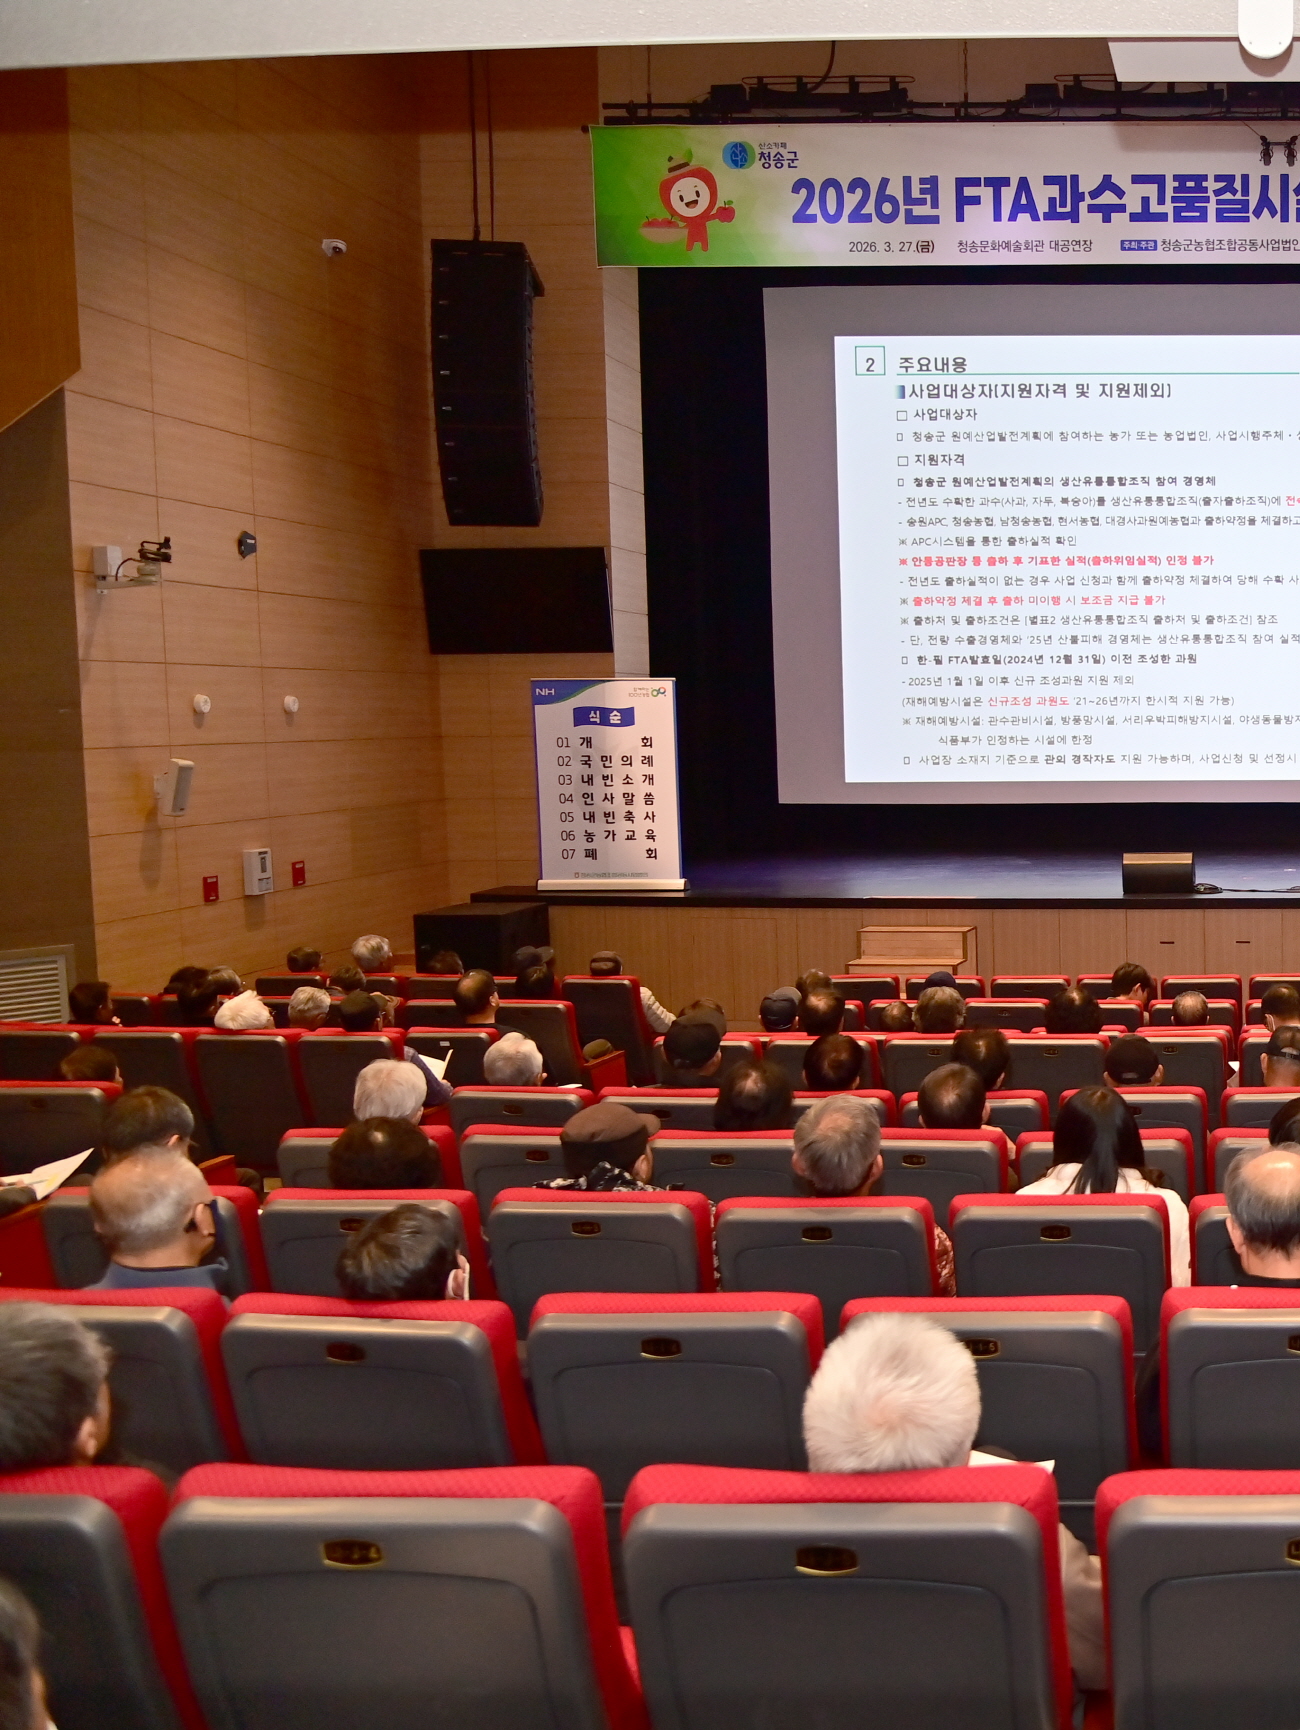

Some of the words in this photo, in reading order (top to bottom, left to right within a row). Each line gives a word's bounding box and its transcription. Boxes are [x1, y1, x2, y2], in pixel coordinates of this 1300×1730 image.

[758, 151, 799, 170] 청송군
[791, 175, 940, 225] 2026년
[849, 241, 880, 253] 2026.
[884, 241, 894, 253] 3.
[899, 240, 935, 254] 27.(금)
[957, 239, 1045, 254] 청송문화예술회관
[1049, 239, 1093, 253] 대공연장
[866, 357, 875, 372] 2
[899, 357, 967, 373] 주요내용
[1076, 383, 1089, 398] 및
[914, 408, 977, 421] 사업대상자
[913, 431, 946, 442] 청송군
[1059, 431, 1104, 441] 참여하는
[1109, 431, 1131, 441] 농가
[1136, 431, 1158, 441] 또는
[1216, 430, 1283, 441] 사업시행주체
[915, 454, 964, 466] 지원자격
[913, 477, 947, 487] 청송군
[1156, 476, 1177, 486] 참여
[1183, 476, 1215, 486] 경영체
[906, 497, 938, 507] 전년도
[1106, 516, 1201, 526] 대경사과원예농협과
[1013, 556, 1023, 566] 후
[1028, 556, 1061, 566] 기표한
[1166, 556, 1187, 565] 인정
[908, 577, 940, 587] 전년도
[1004, 576, 1024, 586] 없는
[1029, 576, 1050, 586] 경우
[1054, 576, 1075, 586] 사업
[1080, 575, 1112, 586] 신청과
[1116, 576, 1137, 585] 함께
[1190, 575, 1232, 585] 체결하여
[1237, 575, 1257, 585] 당해
[962, 596, 982, 606] 체결
[987, 596, 998, 606] 후
[1029, 596, 1060, 606] 미이행
[1066, 596, 1075, 605] 시
[1080, 595, 1113, 605] 보조금
[1118, 595, 1139, 605] 지급
[951, 616, 960, 625] 및
[1191, 615, 1200, 624] 및
[1257, 615, 1278, 624] 참조
[1108, 635, 1152, 644] 경영체는
[1253, 634, 1273, 644] 참여
[1050, 654, 1072, 664] 12월
[1111, 654, 1132, 664] 이전
[1138, 654, 1171, 664] 조성한
[1175, 654, 1197, 664] 과원
[909, 677, 942, 686] 2025년
[947, 676, 963, 686] 1월
[968, 676, 983, 686] 1일
[989, 676, 1010, 686] 이후
[1014, 676, 1035, 686] 신규
[1040, 676, 1082, 686] 조성과원
[1088, 675, 1108, 685] 지원
[1113, 676, 1133, 685] 제외
[536, 688, 555, 696] NH
[988, 697, 1031, 706] 신규조성
[1036, 696, 1069, 706] 과원도
[1146, 696, 1177, 706] 한시적
[1184, 696, 1204, 705] 지원
[556, 737, 571, 748] 01
[939, 736, 982, 746] 식품부가
[987, 735, 1030, 745] 인정하는
[1035, 735, 1066, 745] 시설에
[1071, 735, 1092, 745] 한정
[557, 756, 572, 767] 02
[919, 755, 952, 765] 사업장
[957, 755, 989, 765] 소재지
[996, 755, 1039, 765] 기준으로
[1044, 754, 1065, 764] 관외
[1072, 754, 1115, 764] 경작자도
[1121, 754, 1141, 764] 지원
[1199, 753, 1242, 763] 사업신청
[1249, 754, 1258, 763] 및
[1264, 754, 1296, 763] 선정시
[558, 774, 573, 786] 03
[559, 793, 574, 804] 04
[560, 811, 574, 823] 05
[561, 830, 576, 841] 06
[561, 849, 576, 860] 07
